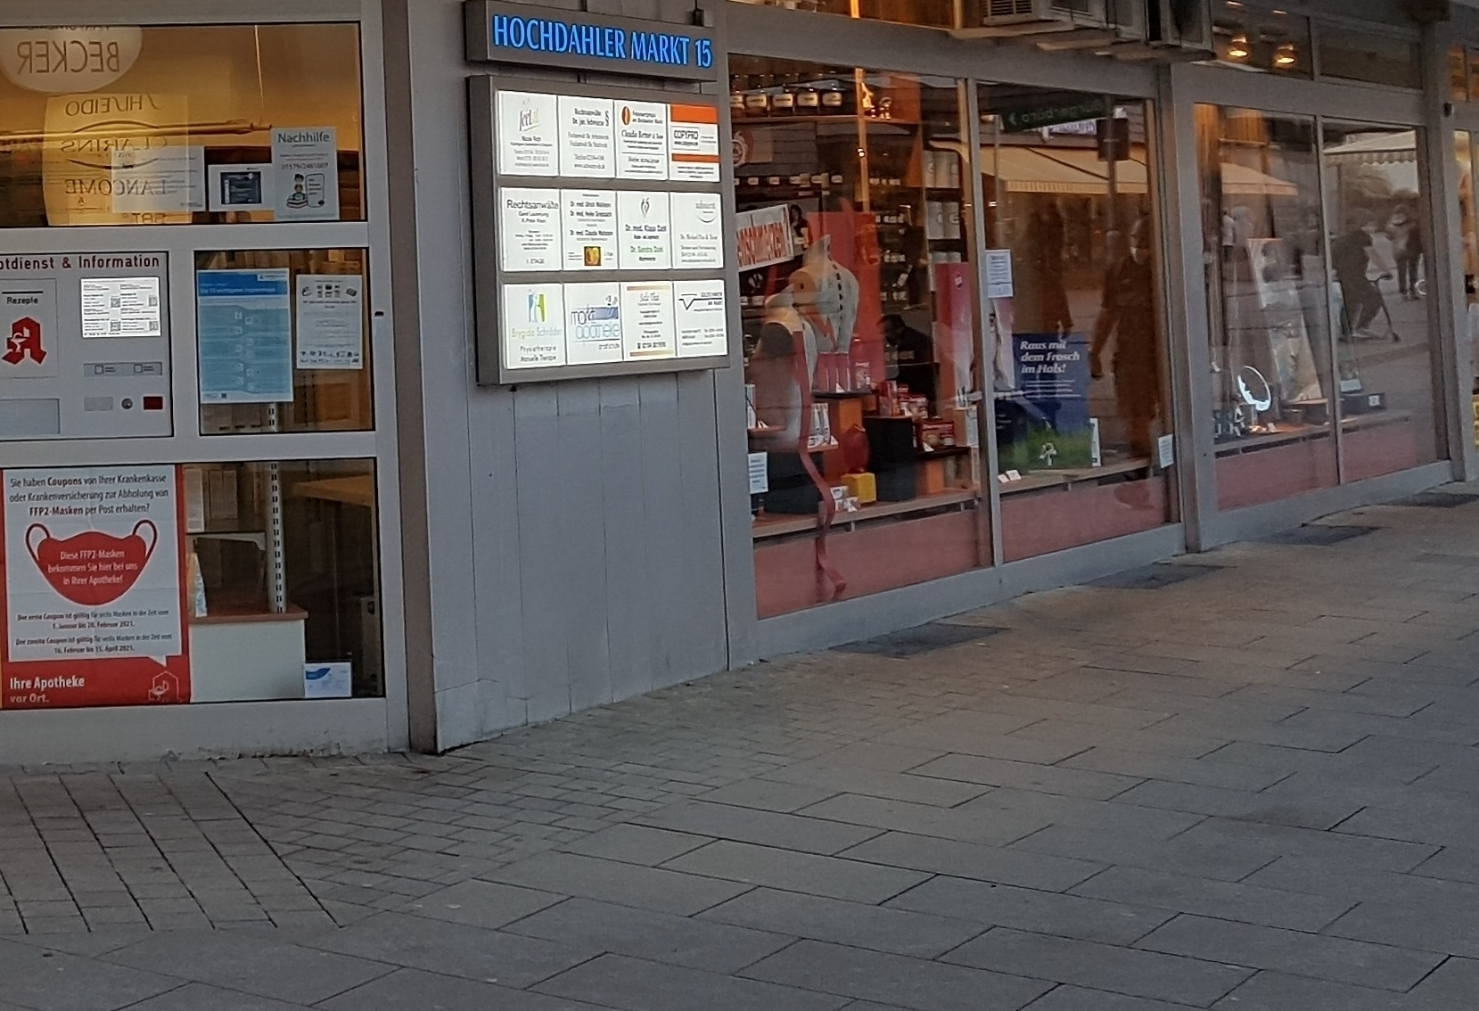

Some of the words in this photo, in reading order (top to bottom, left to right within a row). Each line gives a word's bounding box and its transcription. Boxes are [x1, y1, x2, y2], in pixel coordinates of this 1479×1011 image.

[492, 14, 626, 60] HOCHDAHLER
[630, 31, 690, 67] MARKT
[695, 38, 713, 69] 15
[277, 131, 330, 144] Nachhilfe
[62, 257, 71, 268] &
[78, 255, 159, 268] Information
[1020, 341, 1046, 349] Raus
[1048, 340, 1066, 349] mit
[1021, 352, 1044, 361] dem
[1046, 351, 1080, 361] Frosch
[1021, 365, 1035, 373] im
[1036, 363, 1066, 373] Hals!
[10, 478, 21, 488] Sie
[23, 477, 46, 487] haben
[47, 477, 82, 487] Coupons
[99, 476, 116, 484] Ihrer
[118, 474, 166, 483] Krankenkasse
[9, 493, 26, 502] oder
[27, 490, 103, 502] Krankenversicherung
[105, 491, 117, 499] zur
[118, 489, 153, 499] Abholung
[29, 507, 83, 516] FFP2-Masken
[85, 507, 97, 516] per
[98, 506, 114, 514] Post
[116, 504, 150, 513] erhalten?
[60, 551, 78, 560] Diese
[80, 550, 124, 559] FFP2-Masken
[48, 564, 86, 573] bekommen
[87, 564, 97, 572] Sie
[99, 563, 112, 571] hier
[113, 562, 124, 570] bei
[89, 574, 123, 586] Apotheke!
[9, 676, 32, 690] Ihre
[34, 674, 85, 691] Apotheke
[9, 694, 29, 703] vor
[31, 691, 50, 703] Ort.
